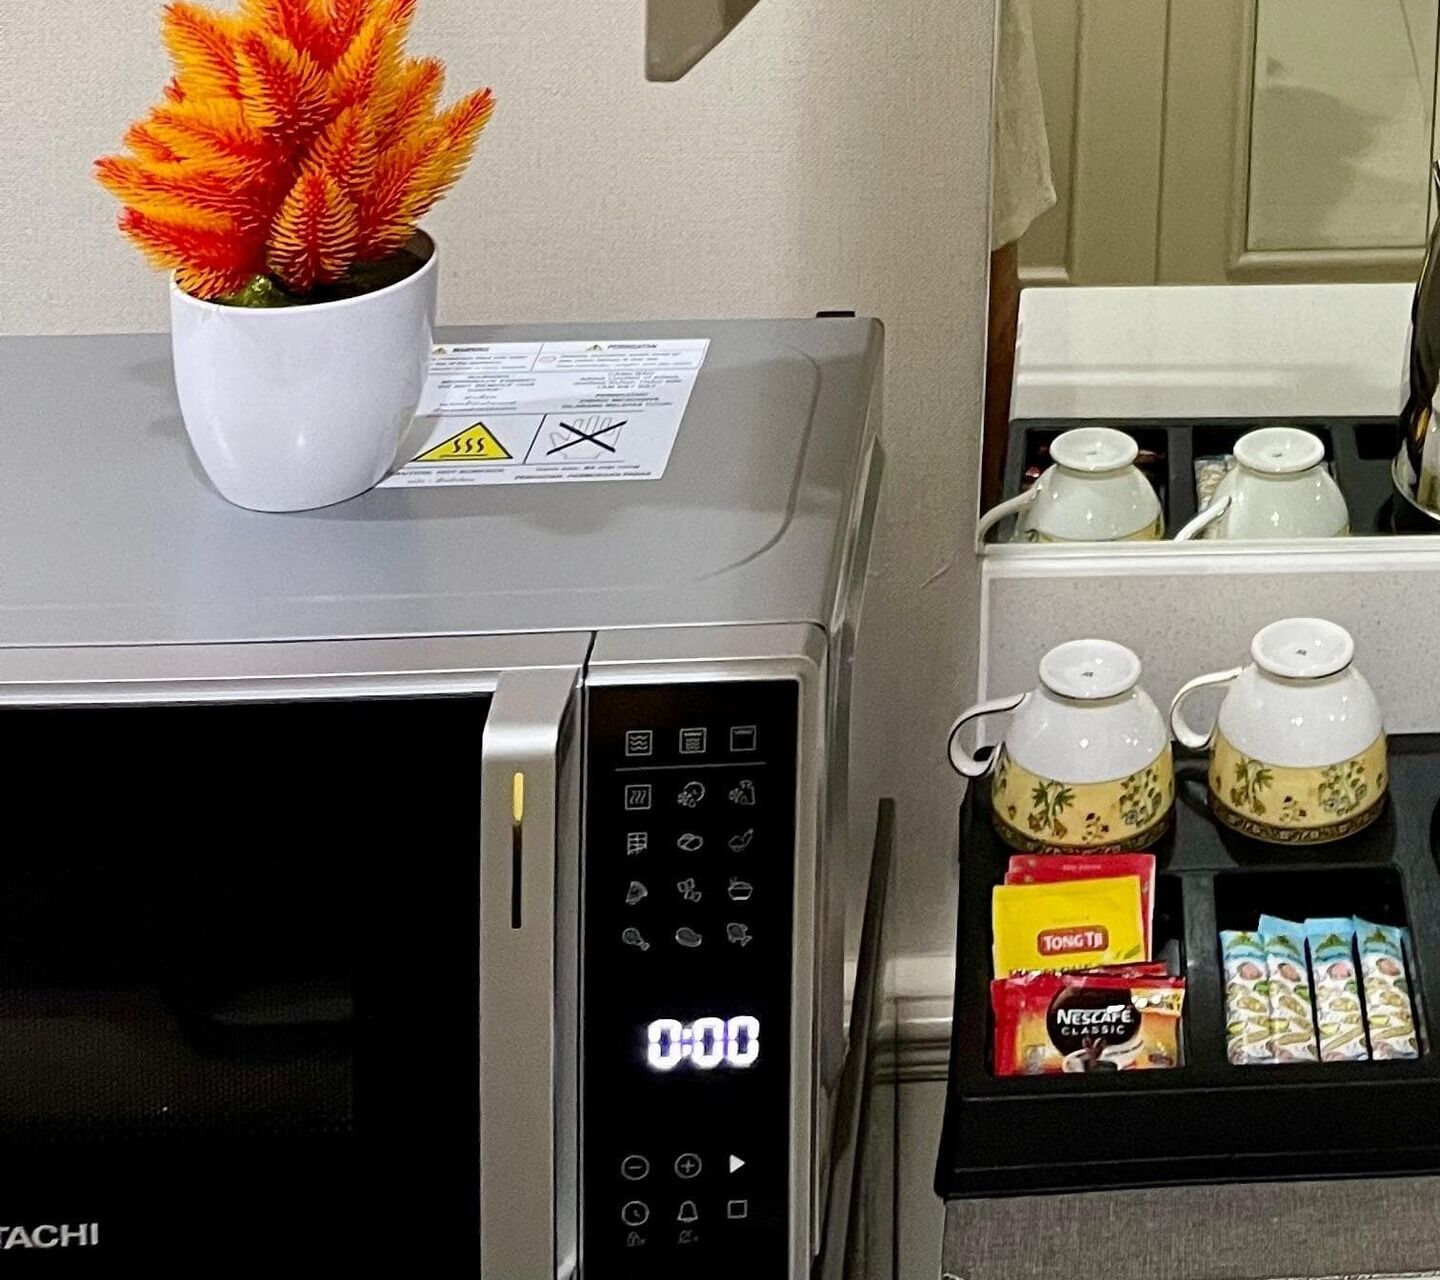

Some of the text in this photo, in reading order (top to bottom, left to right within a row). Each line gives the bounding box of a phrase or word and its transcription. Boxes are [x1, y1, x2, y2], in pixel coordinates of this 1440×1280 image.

[1043, 933, 1084, 952] TONG
[1061, 1024, 1125, 1036] CLASSIC
[647, 1015, 760, 1070] 0:00
